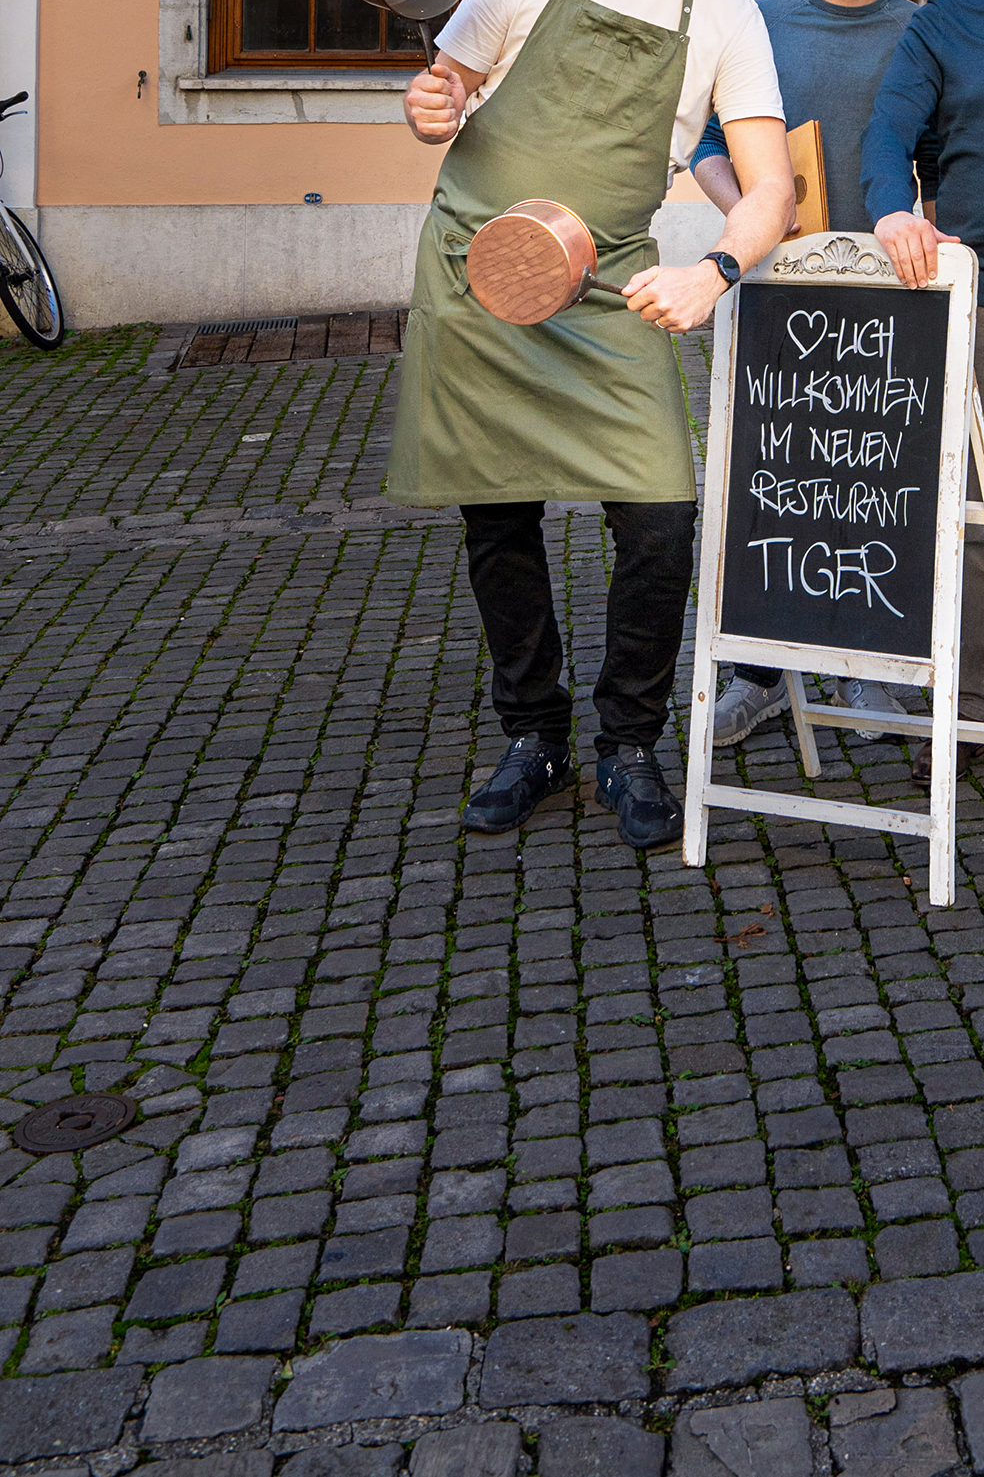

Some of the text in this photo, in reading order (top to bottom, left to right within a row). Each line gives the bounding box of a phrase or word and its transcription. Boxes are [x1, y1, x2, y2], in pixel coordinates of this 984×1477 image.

[746, 362, 930, 427] WILLKOMMEN
[760, 422, 903, 471] IM NEUEN
[749, 468, 921, 528] RESTAURANT
[747, 536, 905, 619] TIGER
